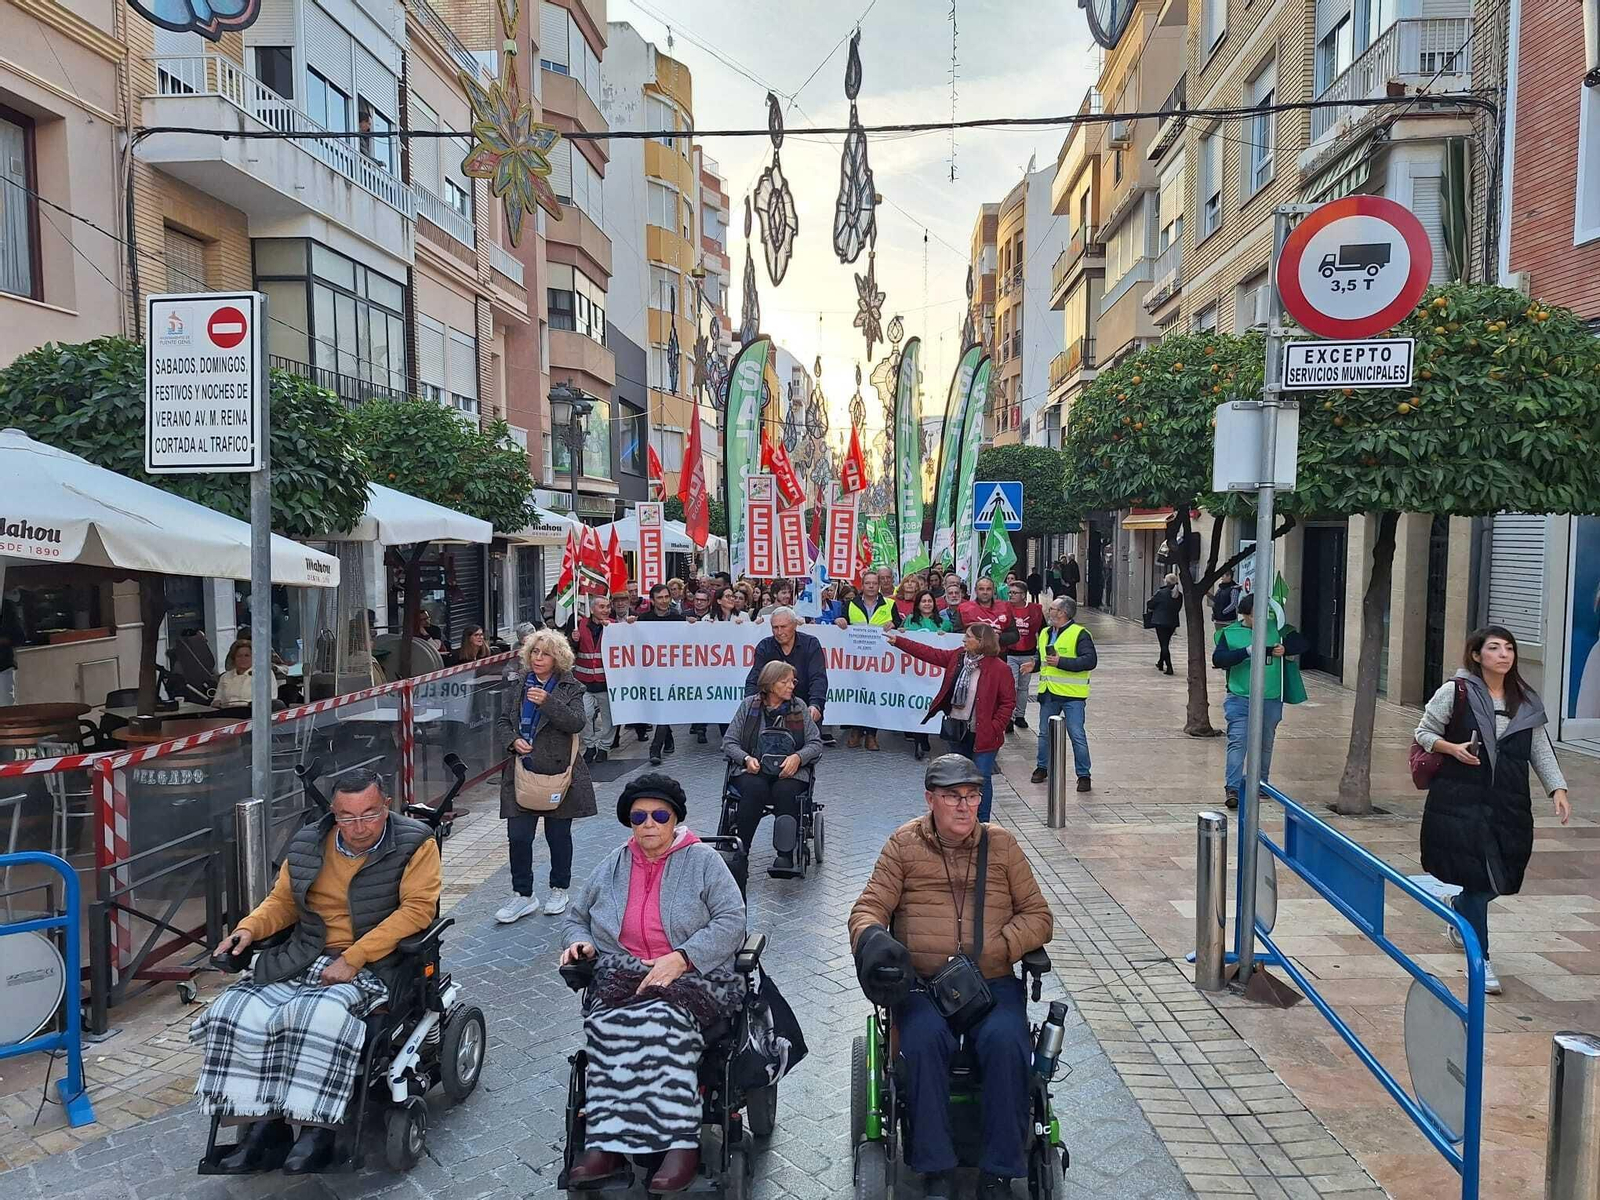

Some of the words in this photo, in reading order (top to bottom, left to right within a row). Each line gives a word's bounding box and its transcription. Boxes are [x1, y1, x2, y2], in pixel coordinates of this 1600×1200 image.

[1330, 280, 1356, 294] 3,5
[1363, 279, 1375, 290] T
[1305, 347, 1391, 364] EXCEPTO
[155, 357, 198, 376] SABADOS,
[200, 356, 248, 375] DOMINGOS,
[1289, 366, 1338, 382] SERVICIOS
[1341, 365, 1405, 381] MUNICIPALES
[155, 385, 193, 401] FESTIVOS
[194, 384, 200, 400] Y
[202, 383, 235, 400] NOCHES
[237, 383, 248, 399] DE
[155, 410, 191, 427] VERANO
[194, 410, 207, 426] AV.
[209, 409, 219, 426] M.
[221, 409, 248, 426] REINA
[155, 436, 196, 453] CORTADA
[198, 438, 208, 452] AL
[210, 435, 248, 452] TRAFICO
[753, 507, 769, 572] CCOO
[783, 517, 801, 573] CCOO
[833, 513, 850, 574] CCOO
[29, 545, 60, 557] 1890
[305, 557, 331, 574] Mahou
[609, 645, 636, 668] EN
[641, 644, 736, 668] DEFENSA
[609, 688, 617, 702] Y
[621, 686, 647, 701] POR
[650, 687, 664, 701] EL
[667, 683, 703, 701] ÁREA
[880, 692, 905, 708] SUR
